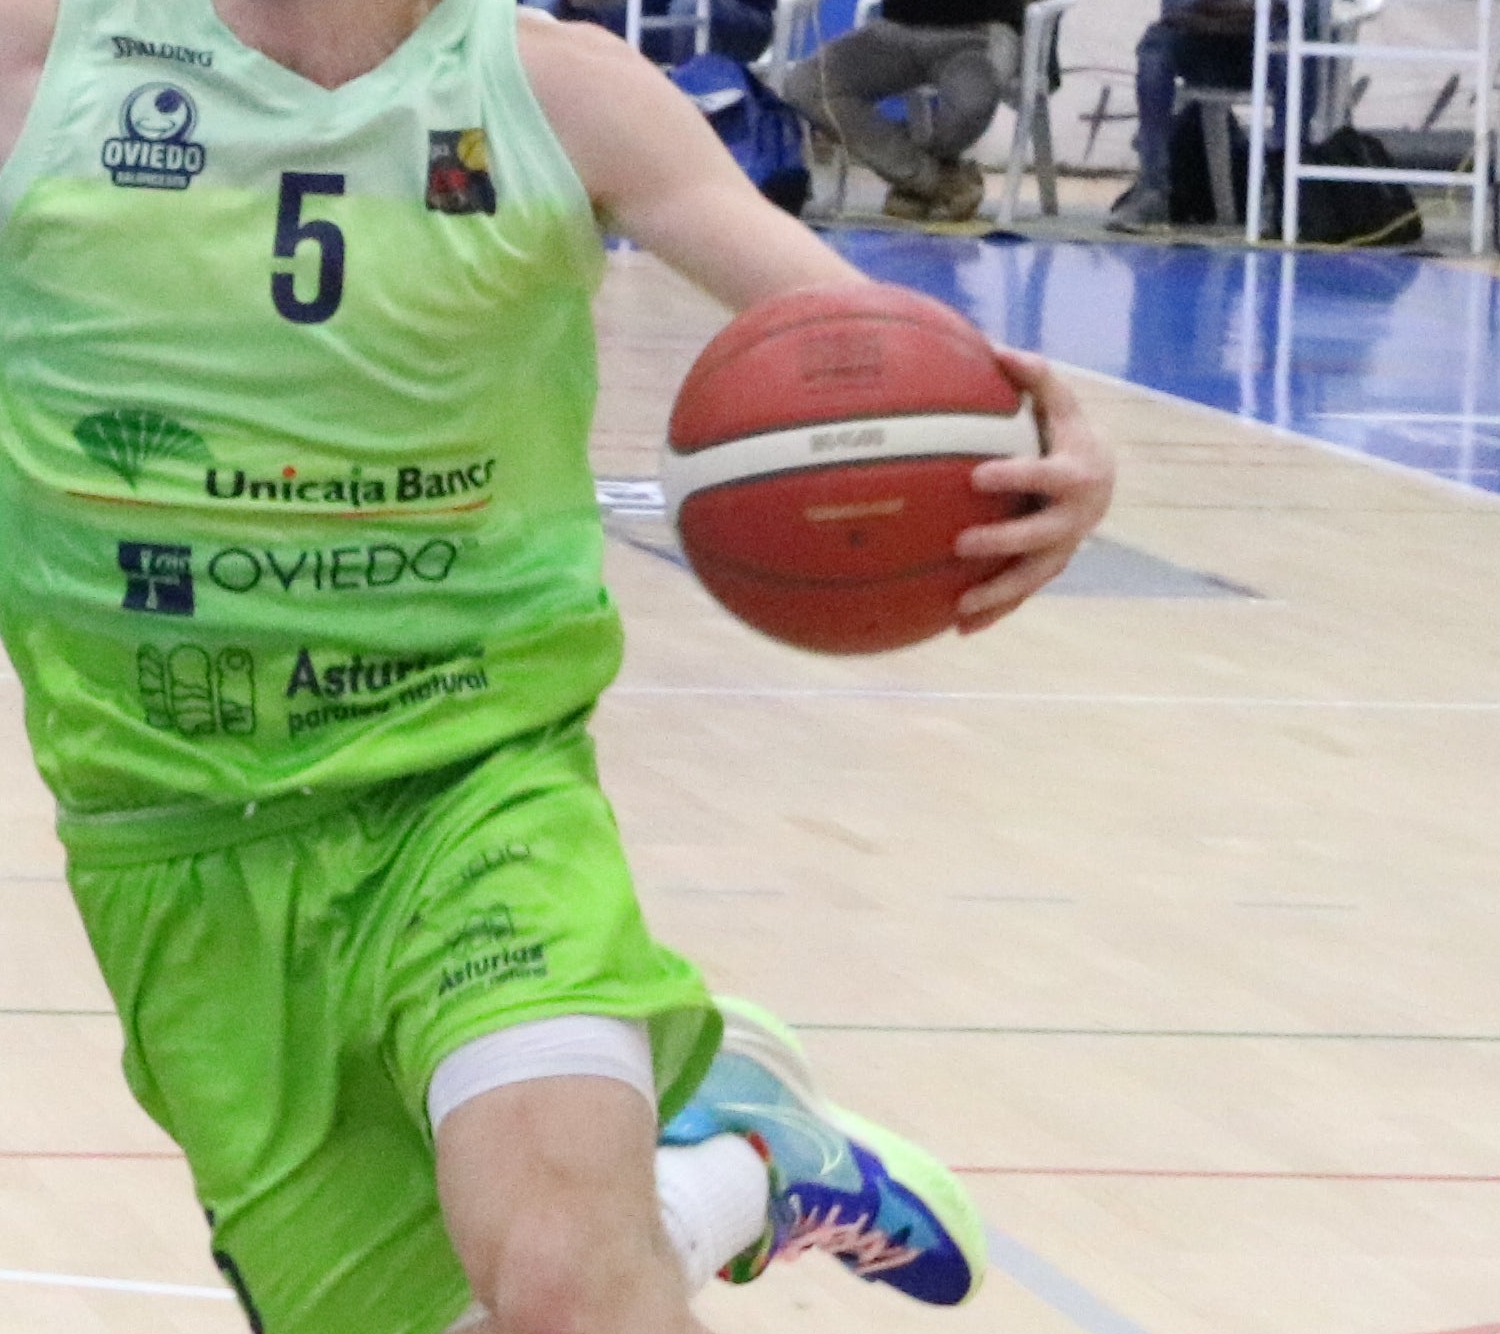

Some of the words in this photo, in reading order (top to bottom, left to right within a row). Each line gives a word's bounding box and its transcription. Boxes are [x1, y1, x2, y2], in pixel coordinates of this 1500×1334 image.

[111, 35, 214, 68] SPALDING
[103, 138, 203, 173] OVIEDO
[269, 172, 347, 325] 5
[205, 465, 386, 508] Unicaja
[207, 538, 458, 594] OVIEDO
[285, 643, 485, 701] Astur
